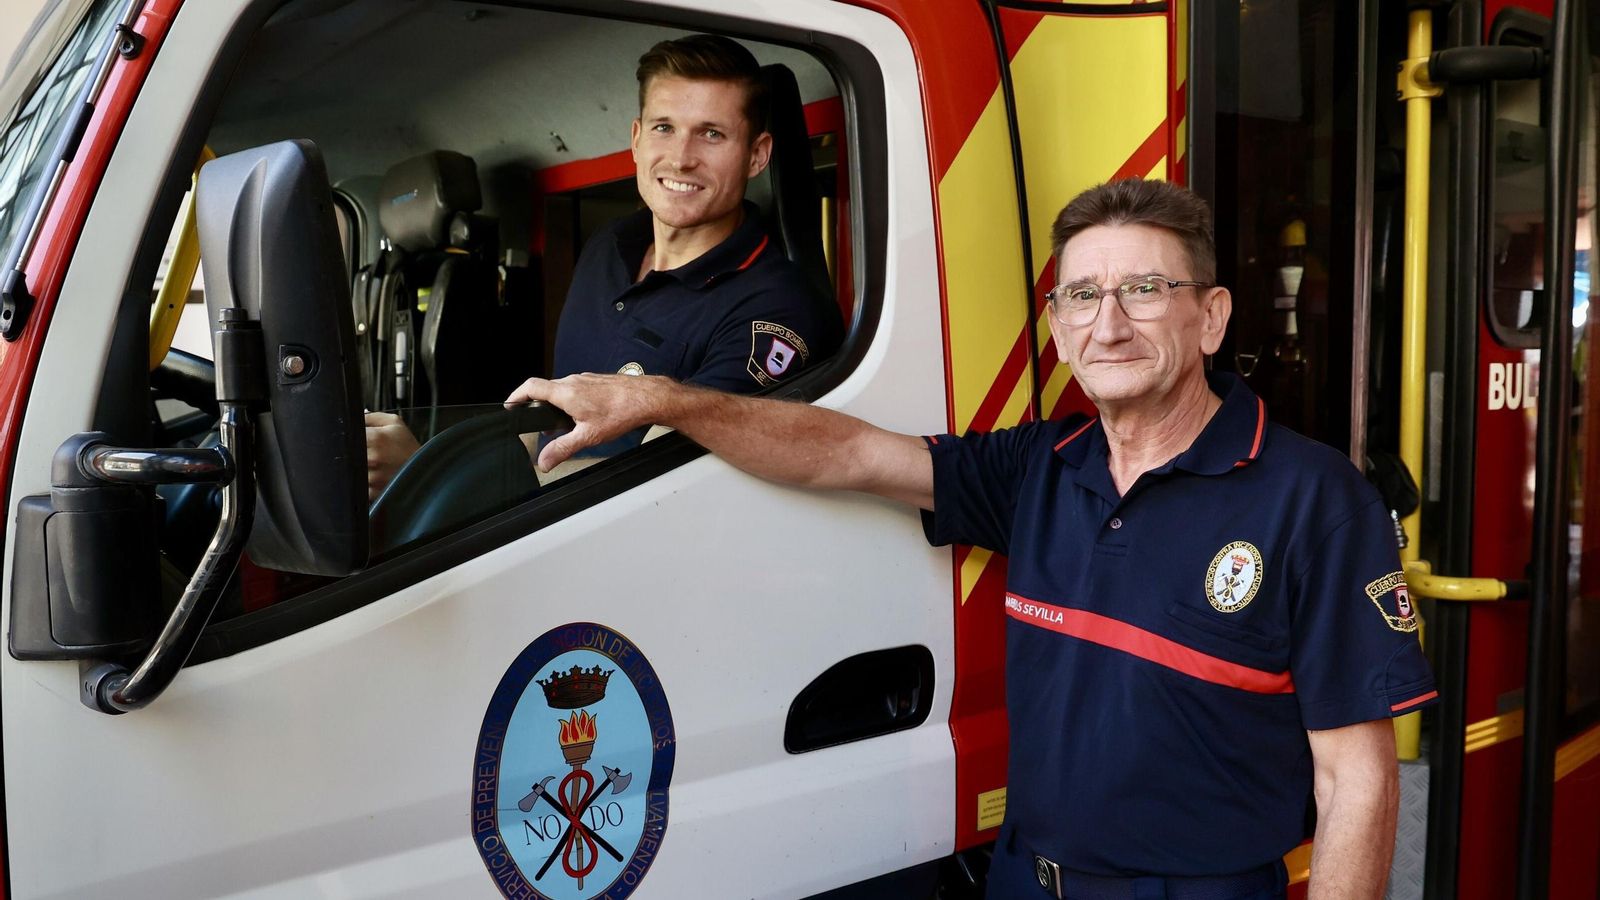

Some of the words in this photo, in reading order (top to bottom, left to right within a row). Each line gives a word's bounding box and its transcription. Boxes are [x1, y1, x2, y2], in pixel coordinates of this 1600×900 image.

[755, 323, 785, 336] CUERPO
[1370, 576, 1397, 595] CUERPO
[1022, 603, 1063, 625] SEVILLA
[477, 809, 494, 832] DE
[608, 637, 634, 665] DE
[623, 791, 665, 885] LVAMENTO
[522, 814, 562, 846] NO
[588, 801, 623, 832] DO
